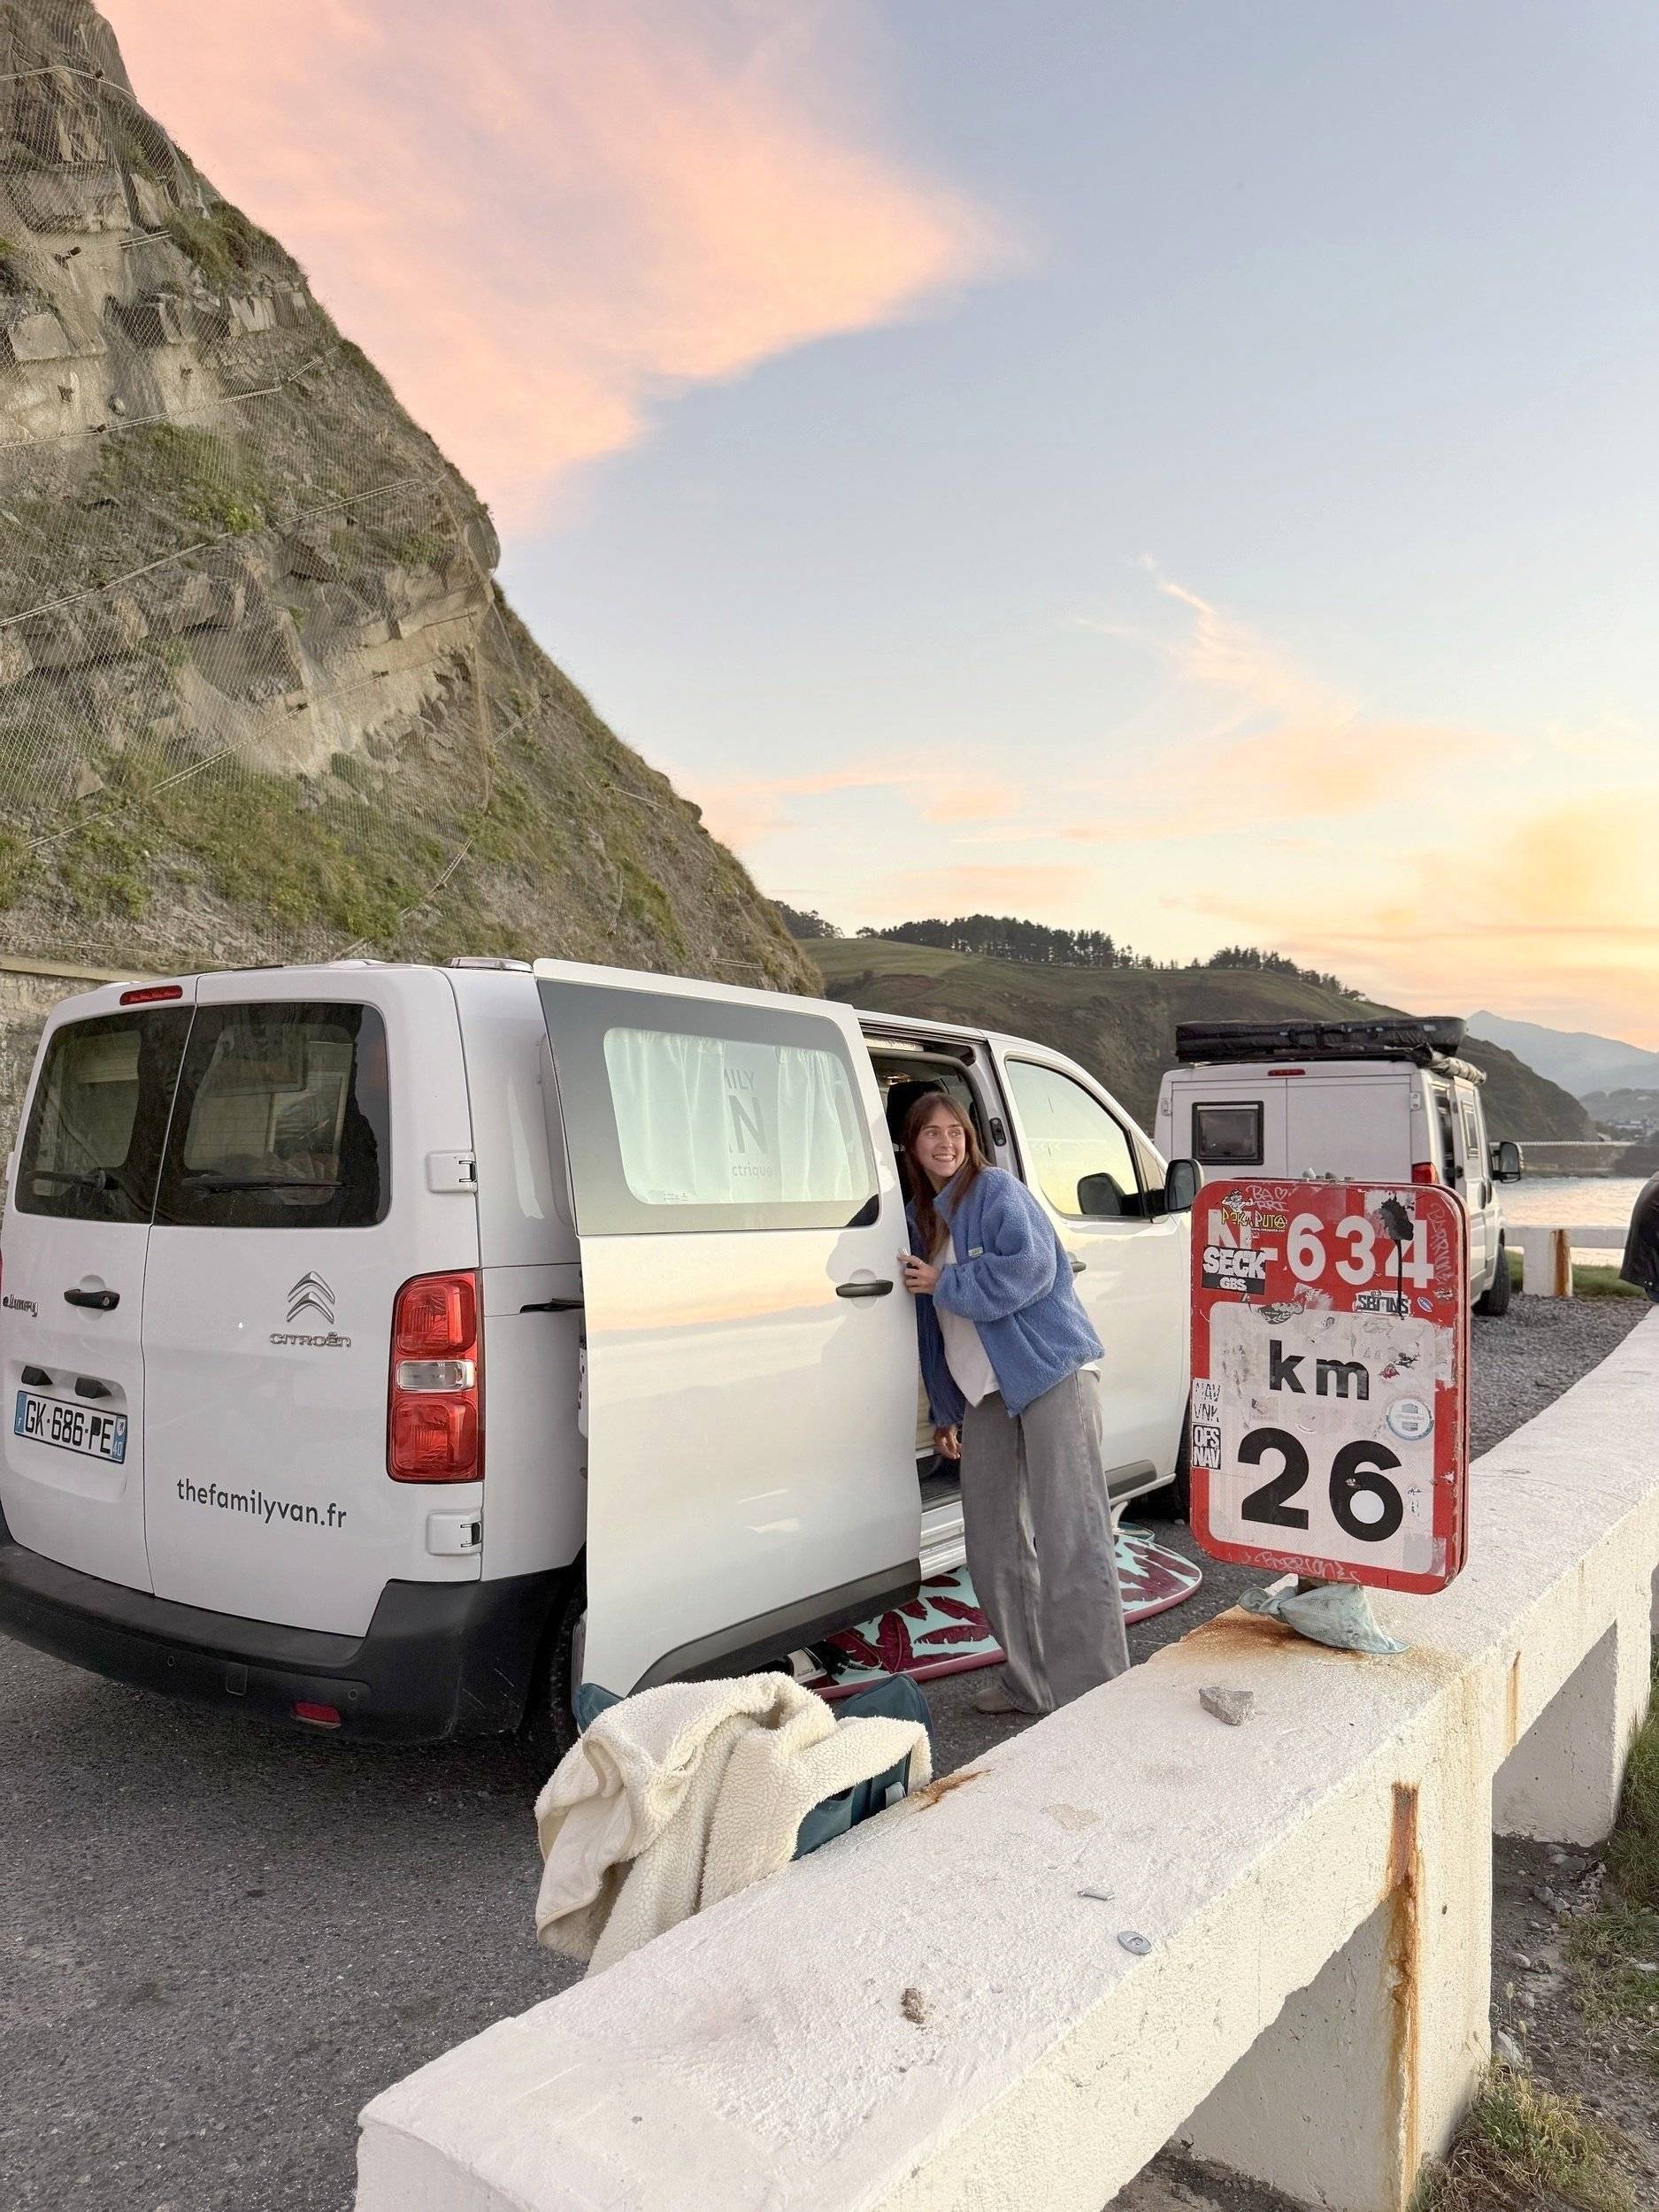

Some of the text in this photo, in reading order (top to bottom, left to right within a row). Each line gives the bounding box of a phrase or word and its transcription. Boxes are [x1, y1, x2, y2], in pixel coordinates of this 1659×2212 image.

[1202, 1246, 1266, 1280] SECK
[1219, 1277, 1248, 1292] GBS
[1270, 1339, 1370, 1401] km
[25, 1400, 113, 1455] GK-686-PE
[112, 1441, 123, 1457] 40
[1194, 1447, 1220, 1469] NAV
[177, 1479, 347, 1528] thefamilyvan.fr
[1237, 1427, 1403, 1542] 26
